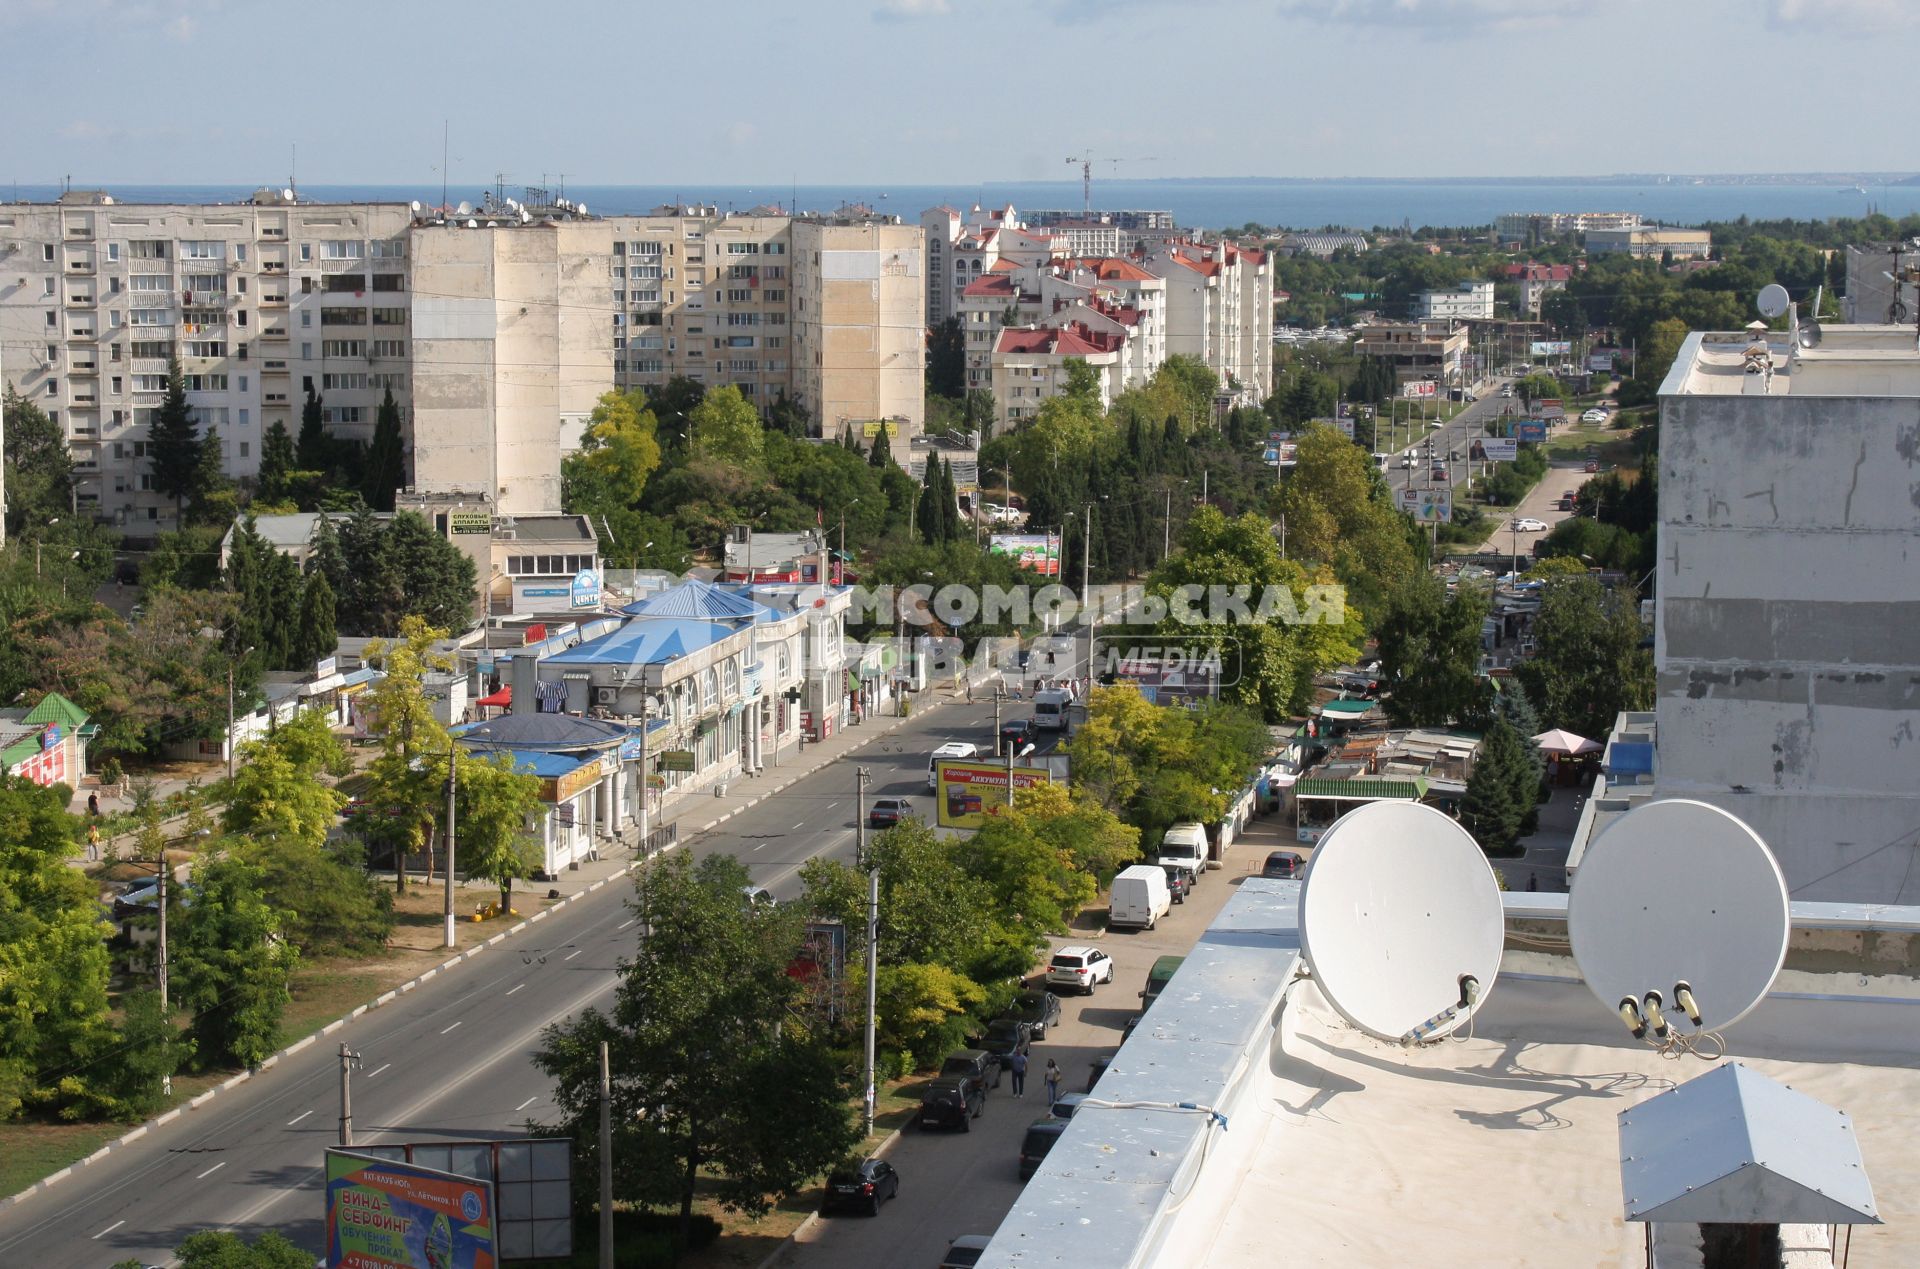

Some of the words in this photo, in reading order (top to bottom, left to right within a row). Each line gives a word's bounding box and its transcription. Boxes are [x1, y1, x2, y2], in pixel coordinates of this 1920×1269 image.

[575, 593, 599, 605] ЦЕНТР
[363, 1172, 393, 1184] ЯХТ-КЛУБ
[342, 1189, 391, 1211] ВИНД-
[452, 1197, 459, 1207] 11
[342, 1207, 412, 1234] СЕРФИНГ
[342, 1226, 392, 1245] ОБУЧЕНИЕ
[368, 1243, 403, 1258] ПРОКАТ
